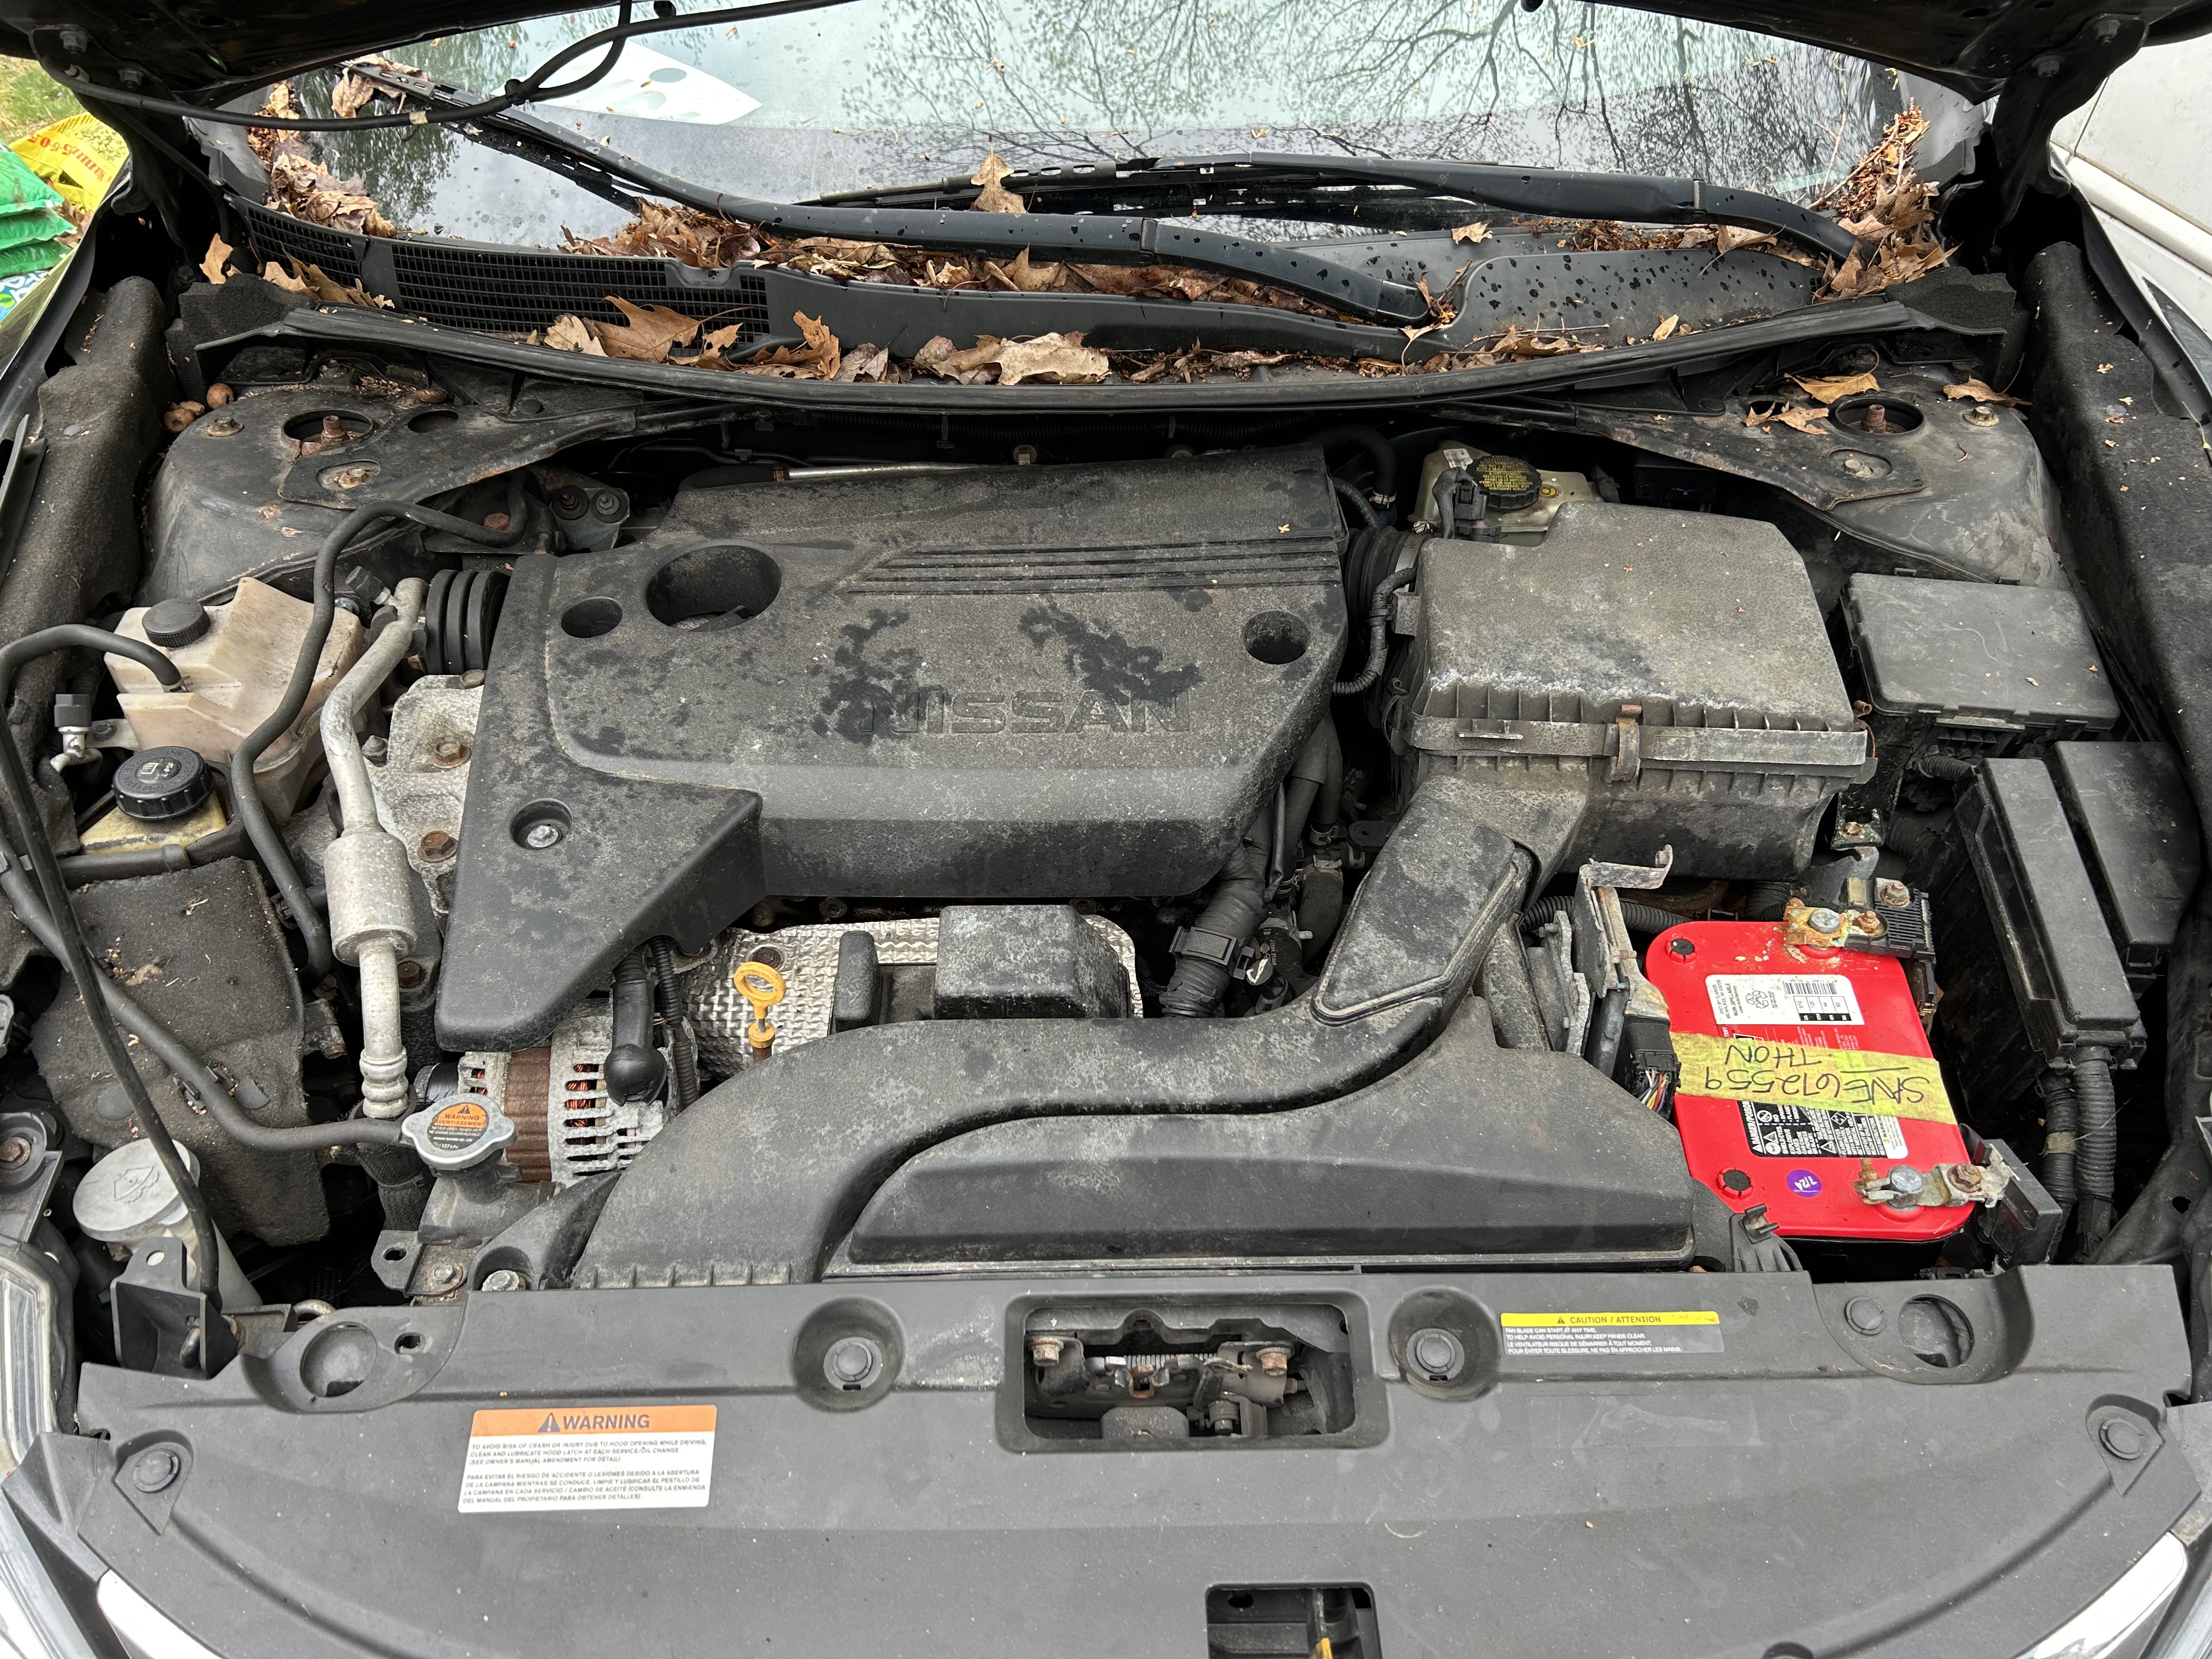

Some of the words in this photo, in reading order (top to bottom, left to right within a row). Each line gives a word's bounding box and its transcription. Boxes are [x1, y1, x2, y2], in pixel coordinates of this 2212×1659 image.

[857, 690, 1192, 734] NISSAN
[1724, 1045, 1822, 1068] THON
[1706, 1066, 1841, 1097] 672559
[1794, 1176, 1818, 1190] 7/24
[563, 1414, 650, 1430] WARNING
